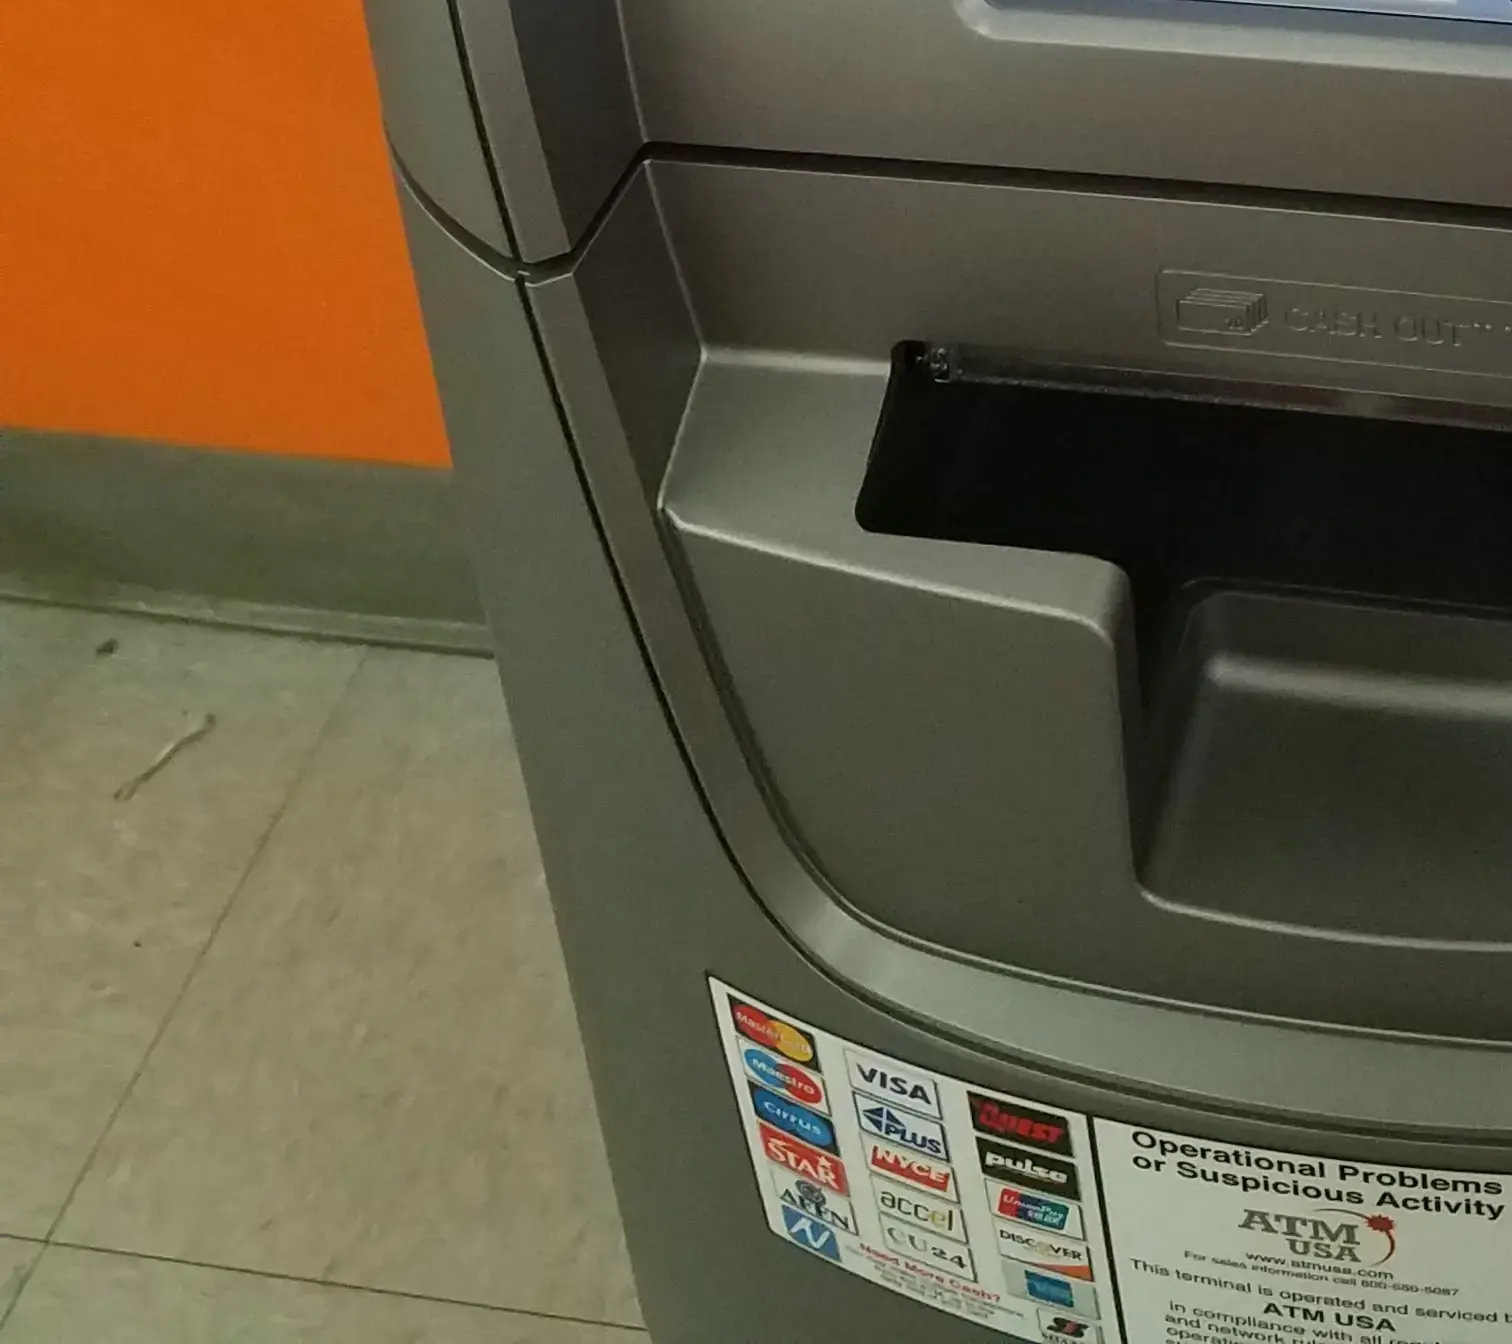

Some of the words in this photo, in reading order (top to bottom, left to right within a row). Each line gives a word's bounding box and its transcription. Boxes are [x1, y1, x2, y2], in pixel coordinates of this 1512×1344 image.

[751, 1058, 815, 1095] Maestro
[856, 1063, 932, 1105] VISA
[884, 1125, 942, 1154] PLUS
[767, 1137, 840, 1190] STAR
[874, 1145, 950, 1185] NYCE
[1131, 1130, 1326, 1178] Operational
[1338, 1163, 1503, 1196] Problems
[1132, 1155, 1167, 1173] or
[1176, 1161, 1365, 1205] Suspicious
[1375, 1191, 1505, 1221] Activity
[879, 1190, 953, 1231] accel
[1237, 1208, 1361, 1247] ATM
[998, 1229, 1082, 1260] DISCOVER
[1285, 1237, 1363, 1263] USA
[1130, 1258, 1171, 1278] This
[1175, 1268, 1252, 1294] terminal
[1257, 1284, 1274, 1297] is
[1279, 1288, 1366, 1311] operated
[1372, 1302, 1409, 1316] and
[1415, 1307, 1498, 1323] serviced
[1251, 1264, 1328, 1282] information
[1164, 1314, 1201, 1329] and
[1207, 1323, 1285, 1344] network
[1192, 1308, 1306, 1335] compliance
[1312, 1329, 1353, 1342] with
[1262, 1302, 1326, 1323] ATM
[1334, 1311, 1397, 1332] USA
